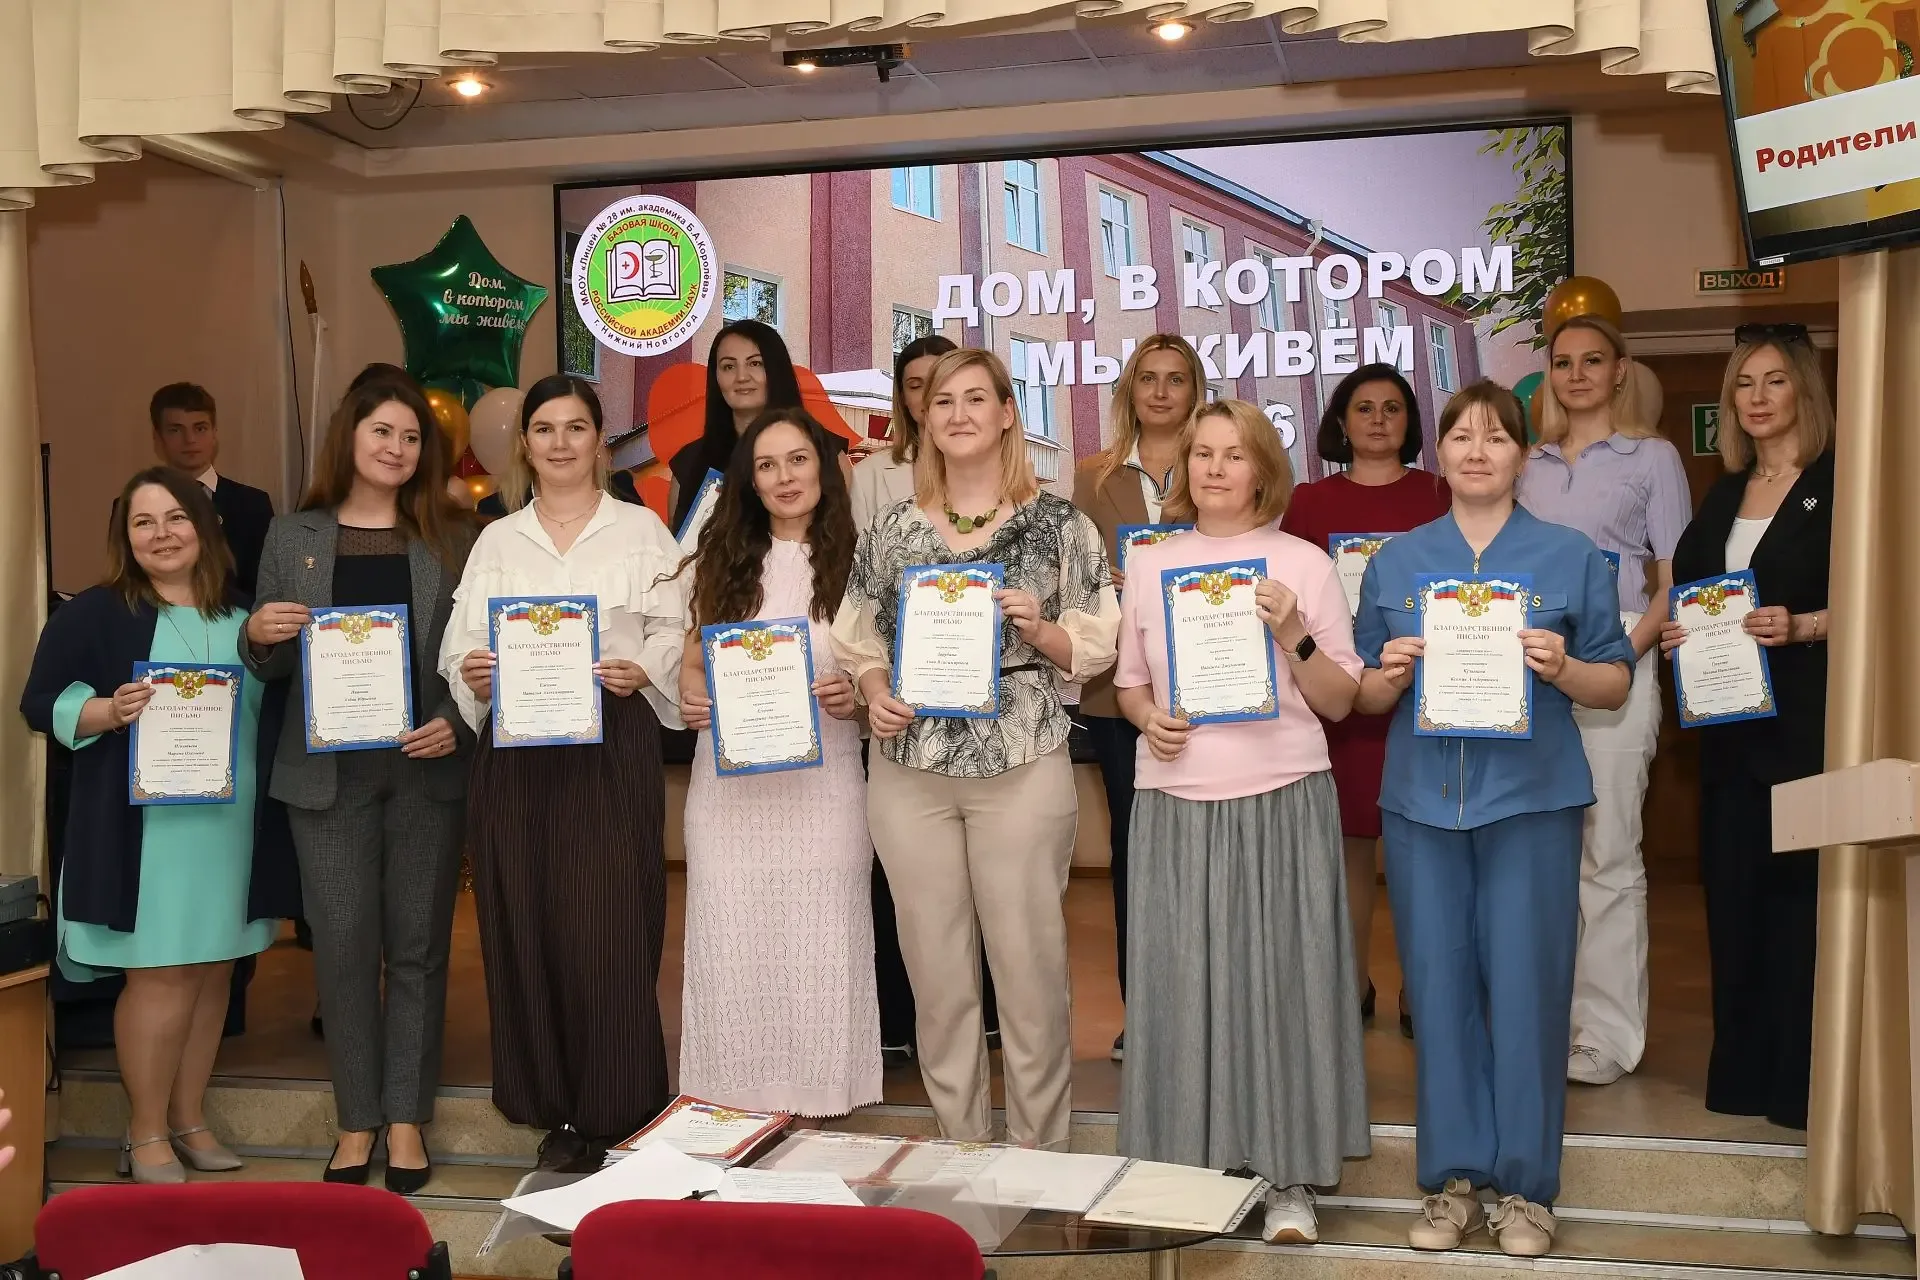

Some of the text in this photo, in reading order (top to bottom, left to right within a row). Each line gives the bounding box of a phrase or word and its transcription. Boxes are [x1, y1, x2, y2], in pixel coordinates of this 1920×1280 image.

[1755, 121, 1917, 173] Родители
[606, 212, 618, 224] 28
[620, 207, 636, 217] им.
[638, 204, 686, 225] академика
[597, 222, 607, 233] №
[607, 219, 679, 242] БАЗОВАЯ ШКОЛА
[581, 233, 598, 270] «Лицей
[469, 271, 506, 292] Дом,
[578, 275, 590, 306] МАОУ
[932, 245, 1515, 328] ДОМ, В КОТОРОМ
[1703, 271, 1775, 289] ВЫХОД
[443, 288, 525, 312] в котором
[591, 283, 698, 337] РОССИЙСКОЙ АКАДЕМИИ НАУК
[439, 313, 470, 326] мы
[601, 326, 642, 350] Нижний
[646, 314, 698, 349] Новгород
[1405, 597, 1414, 609] S
[1531, 595, 1542, 607] S
[1689, 618, 1742, 633] ЛАГОДАРСТВЕНН
